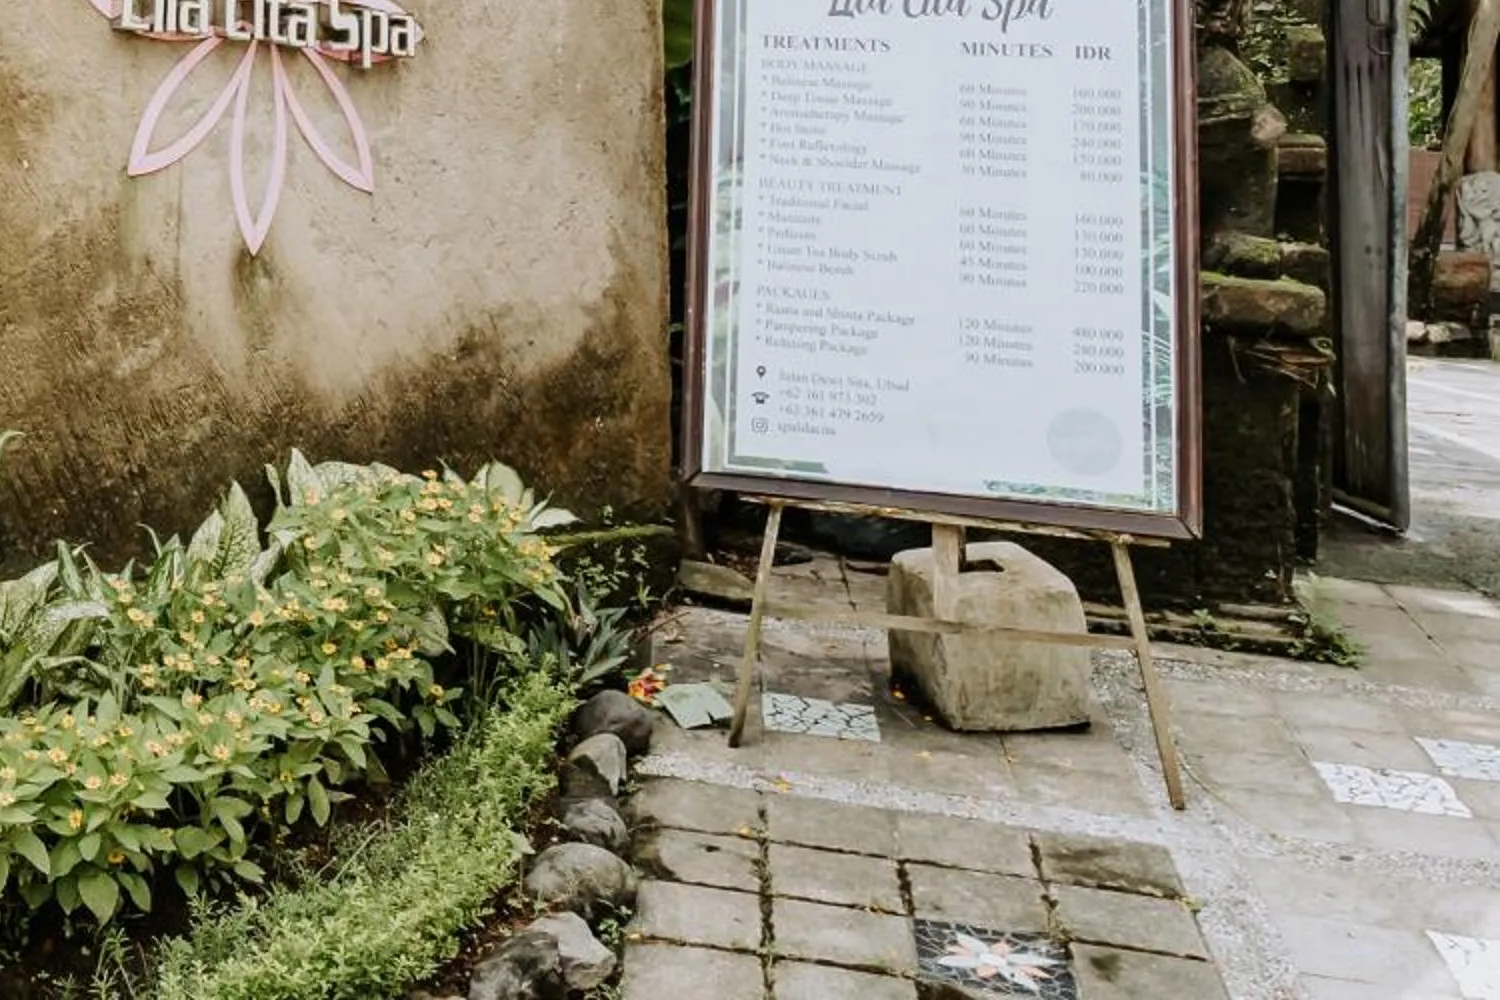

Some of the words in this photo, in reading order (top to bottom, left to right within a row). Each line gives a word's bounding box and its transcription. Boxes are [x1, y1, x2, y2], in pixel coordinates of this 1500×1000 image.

[761, 34, 892, 52] TREATMENTS
[961, 41, 1053, 58] MINUTES
[1075, 45, 1111, 61] IDR
